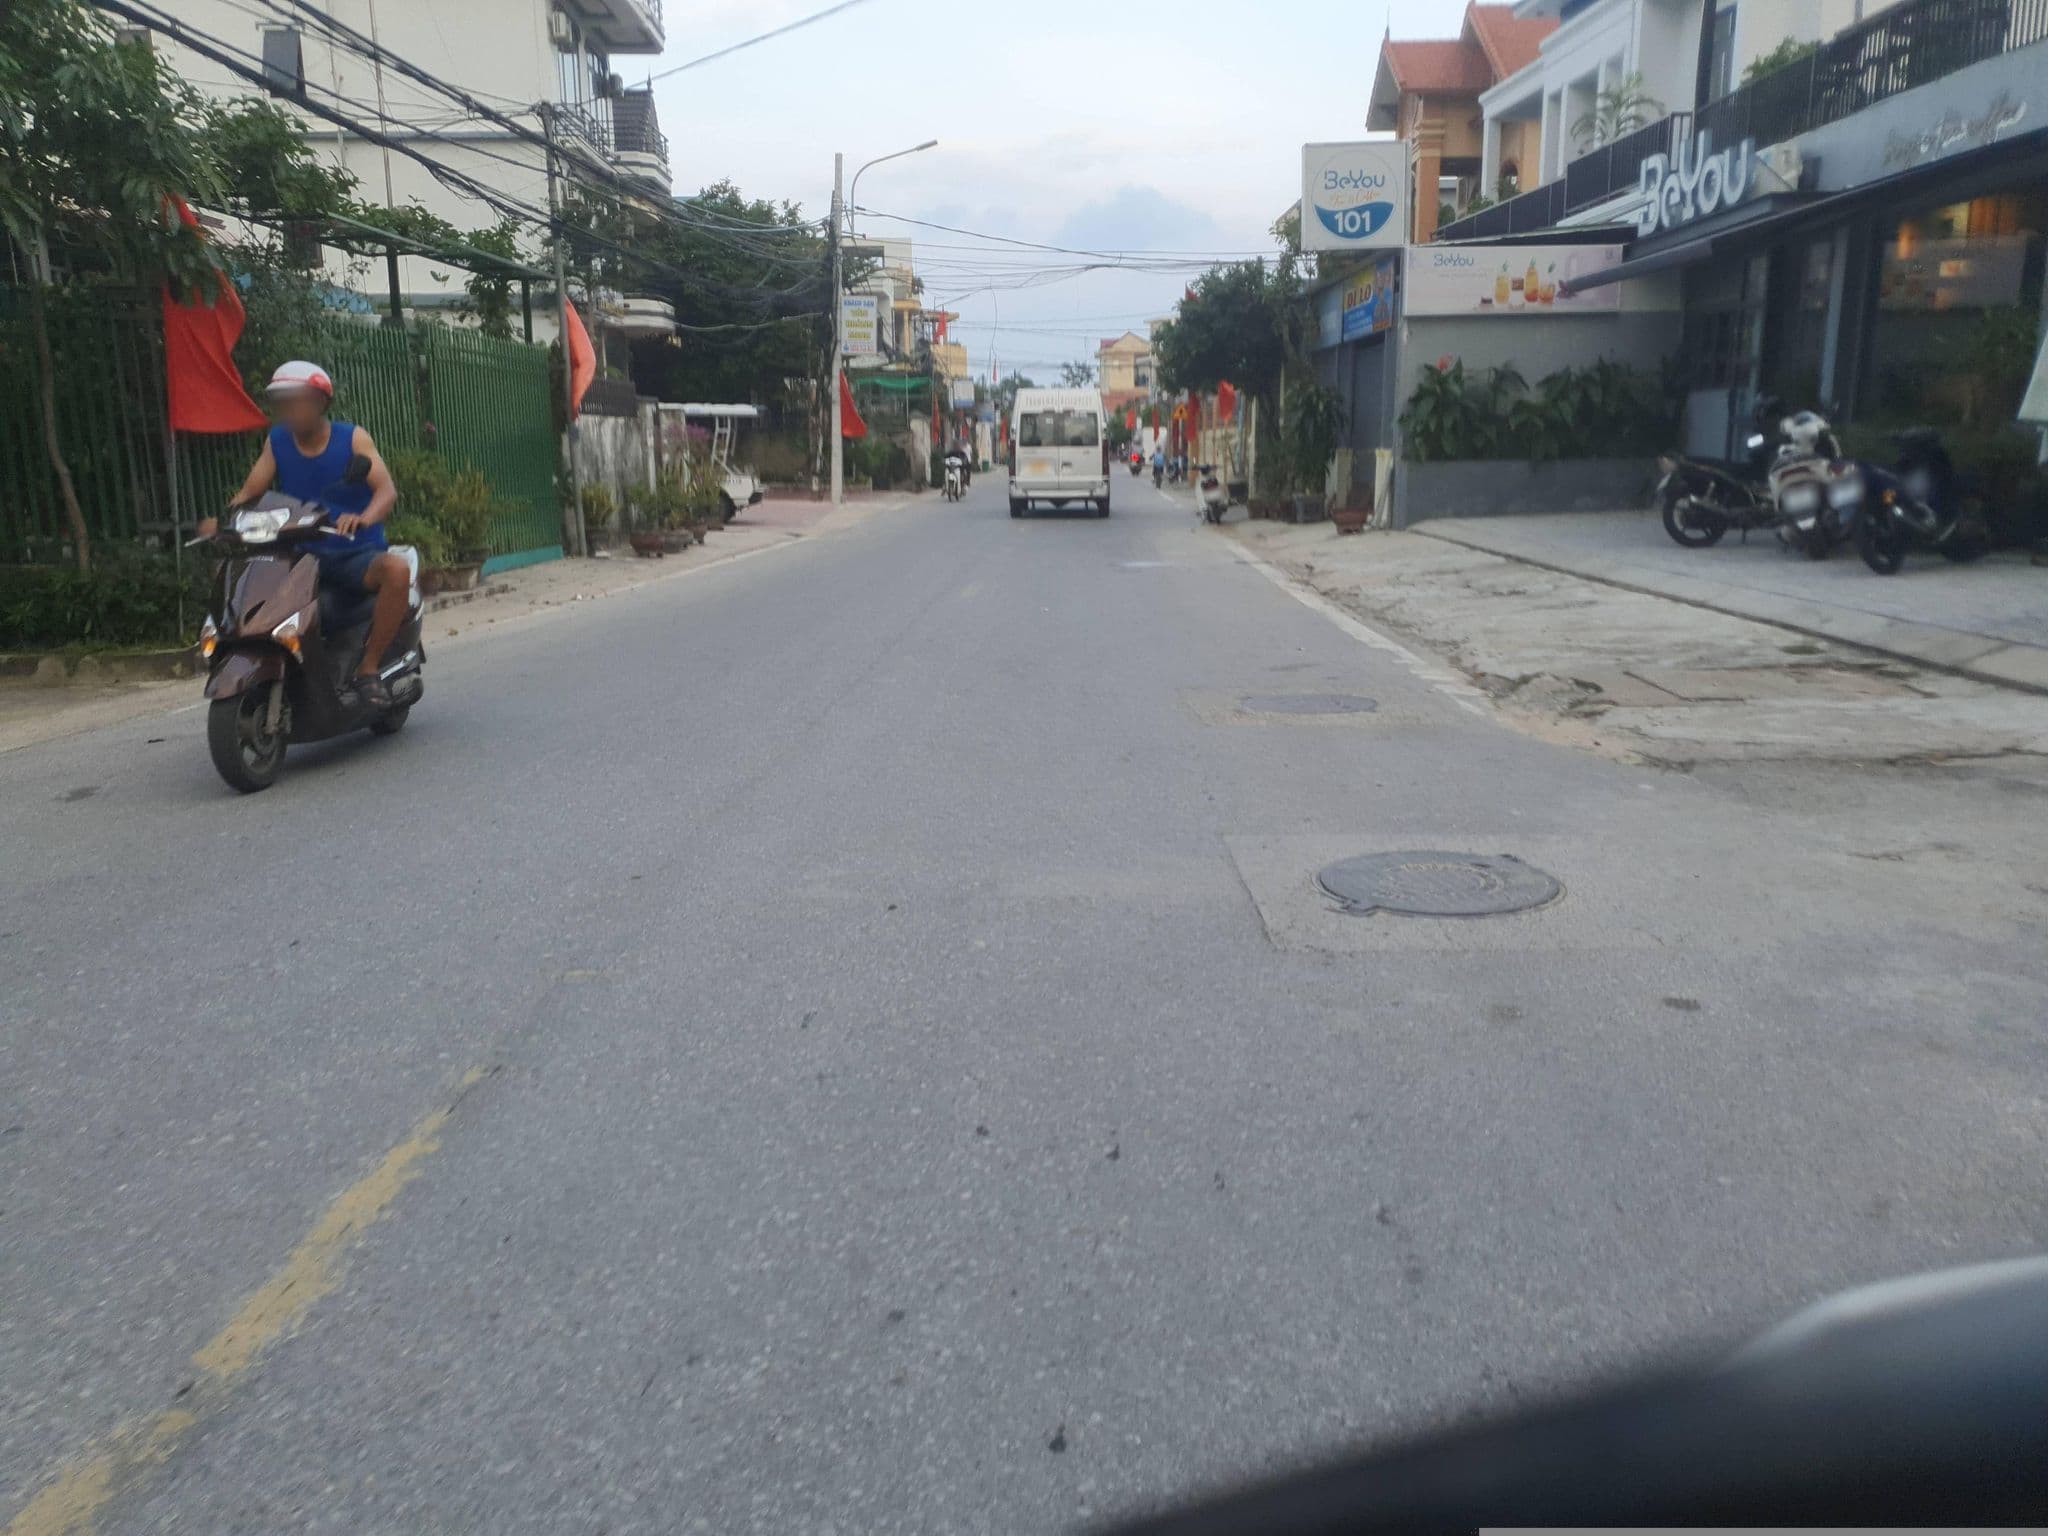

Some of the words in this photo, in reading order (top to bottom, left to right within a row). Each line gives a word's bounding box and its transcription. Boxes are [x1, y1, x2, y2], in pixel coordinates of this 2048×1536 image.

[1324, 169, 1385, 190] BeYou
[1637, 130, 1751, 237] BeYou
[1334, 210, 1371, 234] 101
[1433, 253, 1475, 267] BeYou
